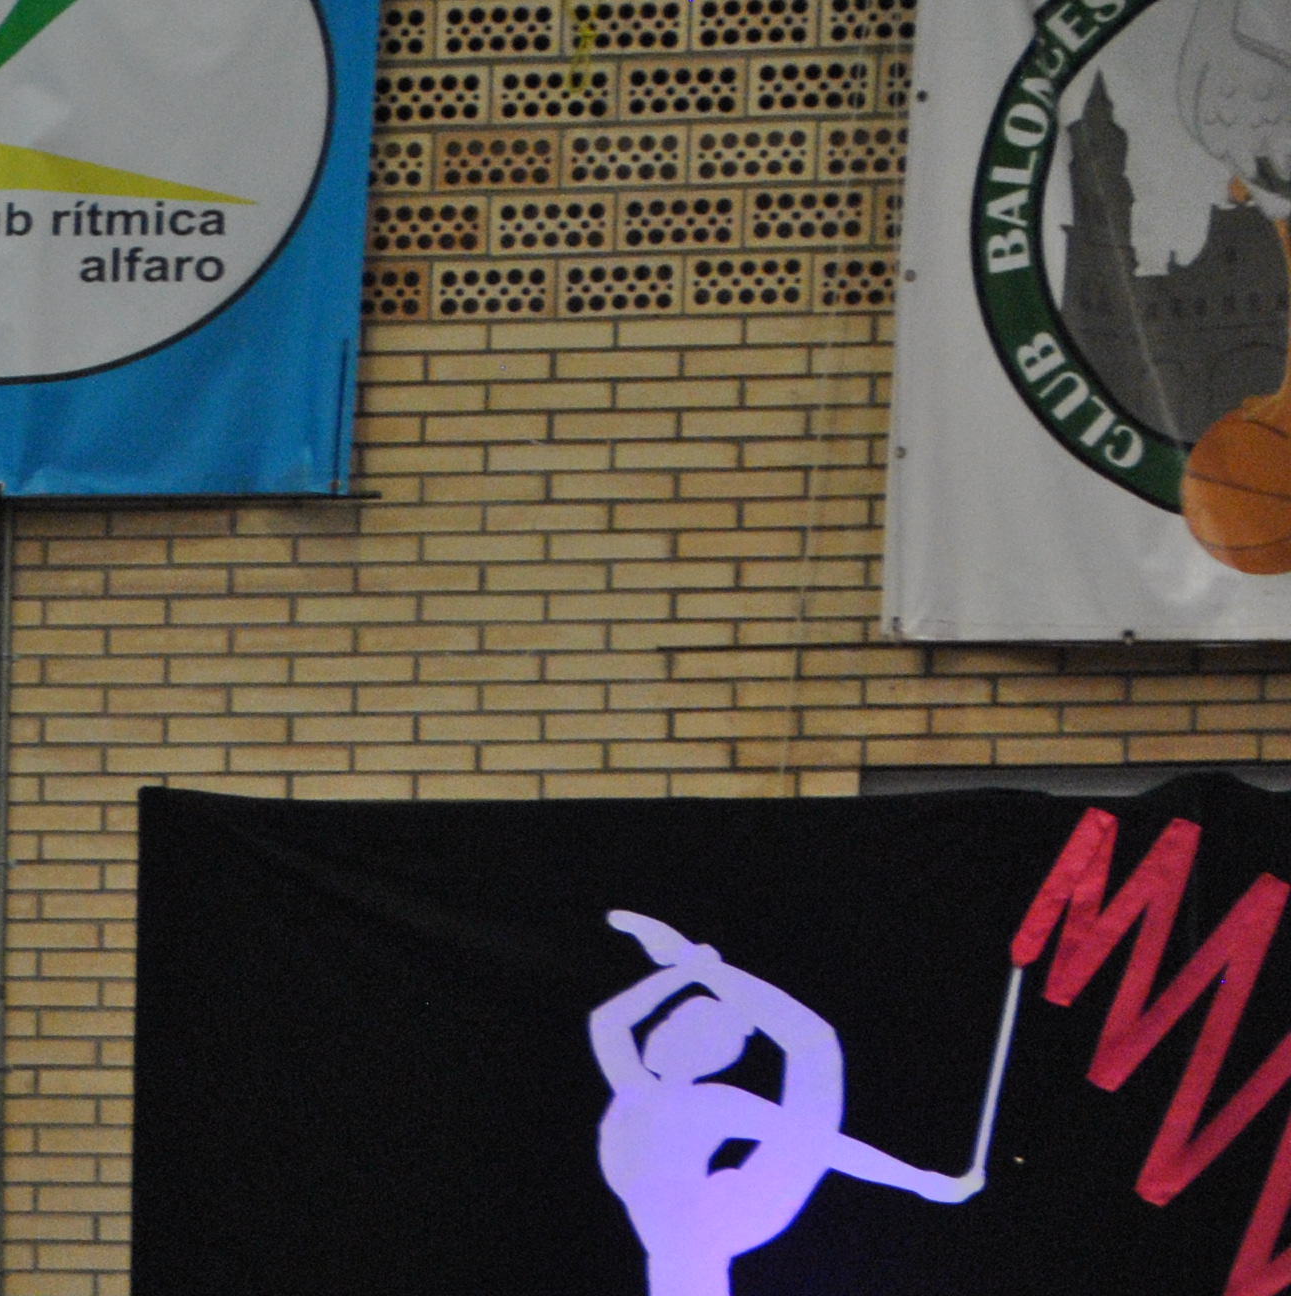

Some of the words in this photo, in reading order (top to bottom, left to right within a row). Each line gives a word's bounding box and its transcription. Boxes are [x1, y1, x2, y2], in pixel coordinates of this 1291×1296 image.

[51, 200, 226, 237] rítmica
[79, 246, 225, 283] alfaro
[1016, 331, 1145, 469] CLUB
